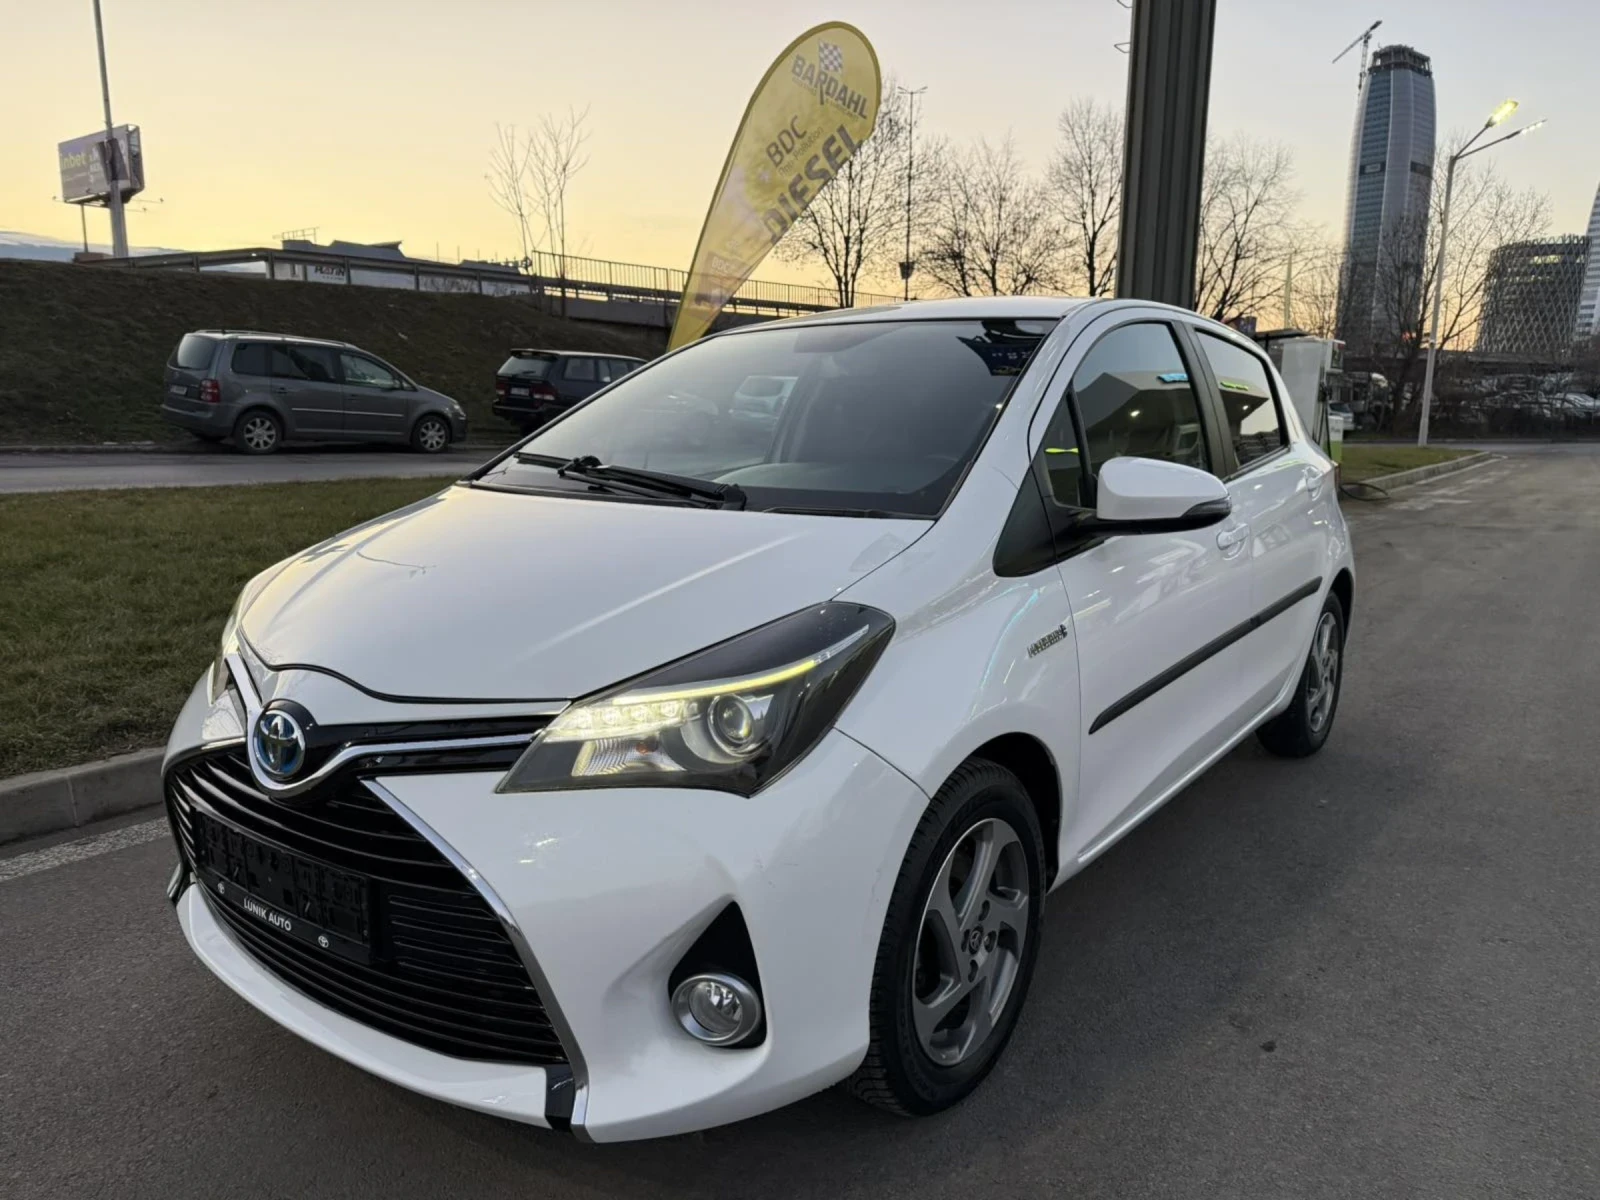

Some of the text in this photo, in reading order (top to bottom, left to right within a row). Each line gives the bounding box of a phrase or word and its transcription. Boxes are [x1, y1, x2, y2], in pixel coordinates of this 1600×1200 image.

[791, 54, 868, 119] BARDAHL
[766, 115, 808, 166] BDC
[762, 124, 863, 244] DIESEL
[243, 897, 292, 932] LUNIK AUTO
